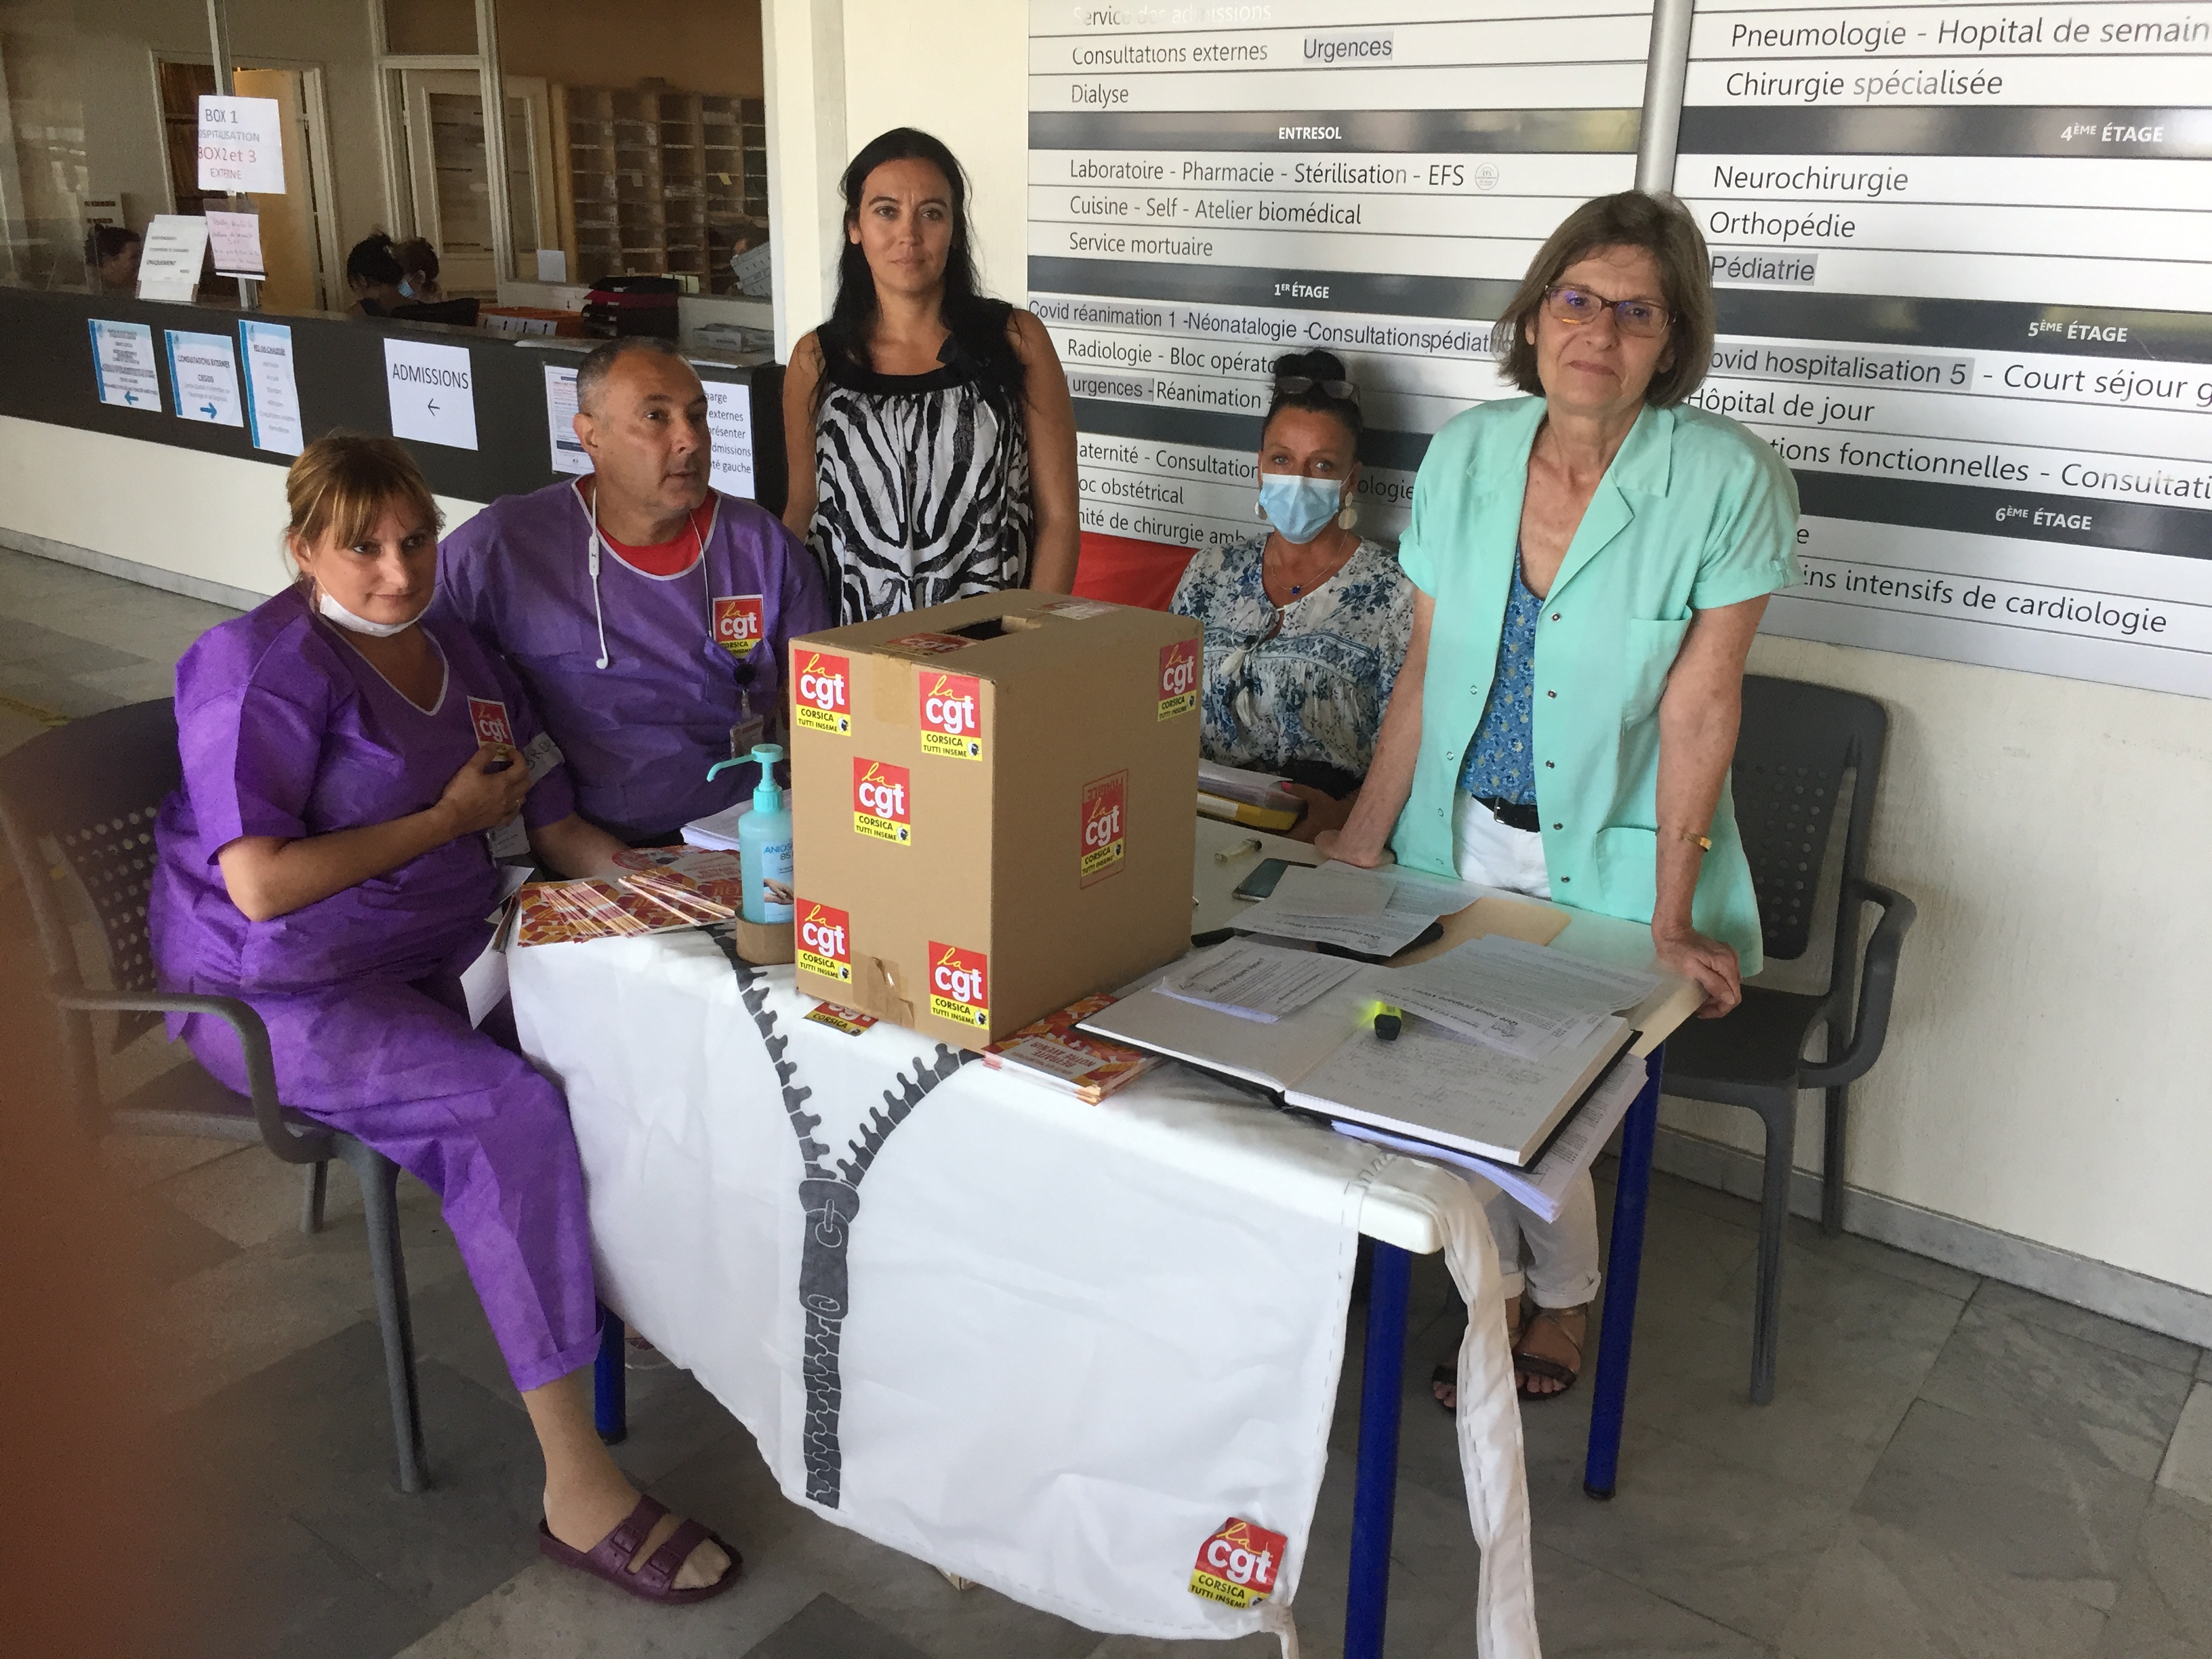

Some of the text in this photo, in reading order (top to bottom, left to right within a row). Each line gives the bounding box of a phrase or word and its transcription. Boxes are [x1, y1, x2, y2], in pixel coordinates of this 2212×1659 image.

[1732, 22, 1906, 52] Pneumologie
[1938, 18, 2043, 50] Hopital
[2053, 17, 2089, 45] de
[1072, 43, 1268, 66] Consultations externes
[1303, 36, 1393, 62] Urgences
[1071, 84, 1128, 107] Dialyse
[1726, 70, 2003, 102] Chirurgie spécialisée
[205, 108, 226, 123] BOX
[199, 129, 260, 142] OSPITALISATION
[1279, 126, 1342, 140] ENTRESOL
[2060, 120, 2164, 143] 4ÈME ÉTAGE
[210, 168, 242, 180] EXTERNE
[1070, 160, 1164, 181] Laboratoire
[1183, 161, 1274, 184] Pharmacie
[1294, 162, 1408, 185] Stérilisation
[1429, 165, 1465, 186] EFS
[1713, 166, 1908, 197] Neurochirurgie
[1070, 197, 1128, 217] Cuisine
[1147, 197, 1176, 217] Self
[1195, 199, 1252, 220] Atelier
[1258, 201, 1361, 225] biomédical
[1709, 211, 1856, 243] Orthopédie
[1069, 233, 1212, 257] Service mortuaire
[1711, 255, 1815, 281] Pédiatrie
[1292, 281, 1330, 299] ÉTAGE
[1029, 300, 1070, 321] Covid
[1073, 303, 1162, 327] réanimation
[1168, 311, 1175, 327] 1
[2028, 319, 2128, 342] 5ÈME ÉTAGE
[1068, 340, 1152, 365] Radiologie
[1170, 346, 1205, 367] Bloc
[392, 362, 469, 390] ADMISSIONS
[1765, 351, 1940, 384] hospitalisation
[1950, 364, 1966, 385] 5
[2003, 365, 2083, 393] Court
[2095, 369, 2188, 402] séjour
[1073, 379, 1261, 409] urgences Réanimation
[1687, 388, 1875, 424] Hôpital de jour
[709, 410, 743, 422] externes
[712, 443, 751, 457] dmissions
[1080, 443, 1139, 464] aternité
[1839, 440, 2029, 481] fonctionnelles
[712, 459, 751, 474] té gauche
[1079, 478, 1184, 506] oc obstétrical
[1357, 477, 1414, 506] ologie
[1079, 508, 1104, 527] nité
[1109, 512, 1128, 530] de
[1134, 516, 1204, 544] chirurgie
[1995, 506, 2092, 530] 6ÈME ÉTAGE
[1845, 569, 1953, 605] intensifs
[1963, 587, 1996, 610] de
[2005, 593, 2167, 635] cardiologie
[721, 612, 758, 639] cgt
[722, 640, 749, 649] ORSICA
[802, 653, 835, 676] la
[1164, 656, 1193, 695] cgt
[800, 674, 845, 710] cgt
[928, 675, 963, 699] la
[801, 708, 834, 722] CORSICA
[926, 695, 975, 734] cgt
[1162, 696, 1185, 710] CORSICA
[480, 718, 509, 743] cgt
[798, 718, 838, 732] TUTTI INSEME
[924, 744, 967, 758] TUTTI INSEME
[926, 733, 963, 747] CORSICA
[862, 762, 894, 786] la
[859, 783, 904, 819] cgt
[856, 825, 897, 841] TUTTI INSEME
[859, 815, 893, 831] CORSICA
[1086, 805, 1120, 846] cgt
[764, 843, 792, 854] ANIOS
[780, 852, 791, 860] 85
[1085, 846, 1111, 865] CORSICA
[805, 905, 836, 926] la
[802, 922, 845, 958] cgt
[800, 962, 839, 979] TUTTI INSEME
[803, 953, 835, 969] CORSICA
[937, 947, 972, 971] la
[935, 966, 982, 1002] cgt
[933, 1007, 975, 1025] TUTTI INSEME
[935, 998, 970, 1015] CORSICA
[813, 1013, 848, 1028] CORSICA
[1216, 1522, 1261, 1553] la
[1208, 1540, 1272, 1584] cgt
[1191, 1584, 1213, 1599] TUTTI
[1198, 1574, 1245, 1599] CORSICA
